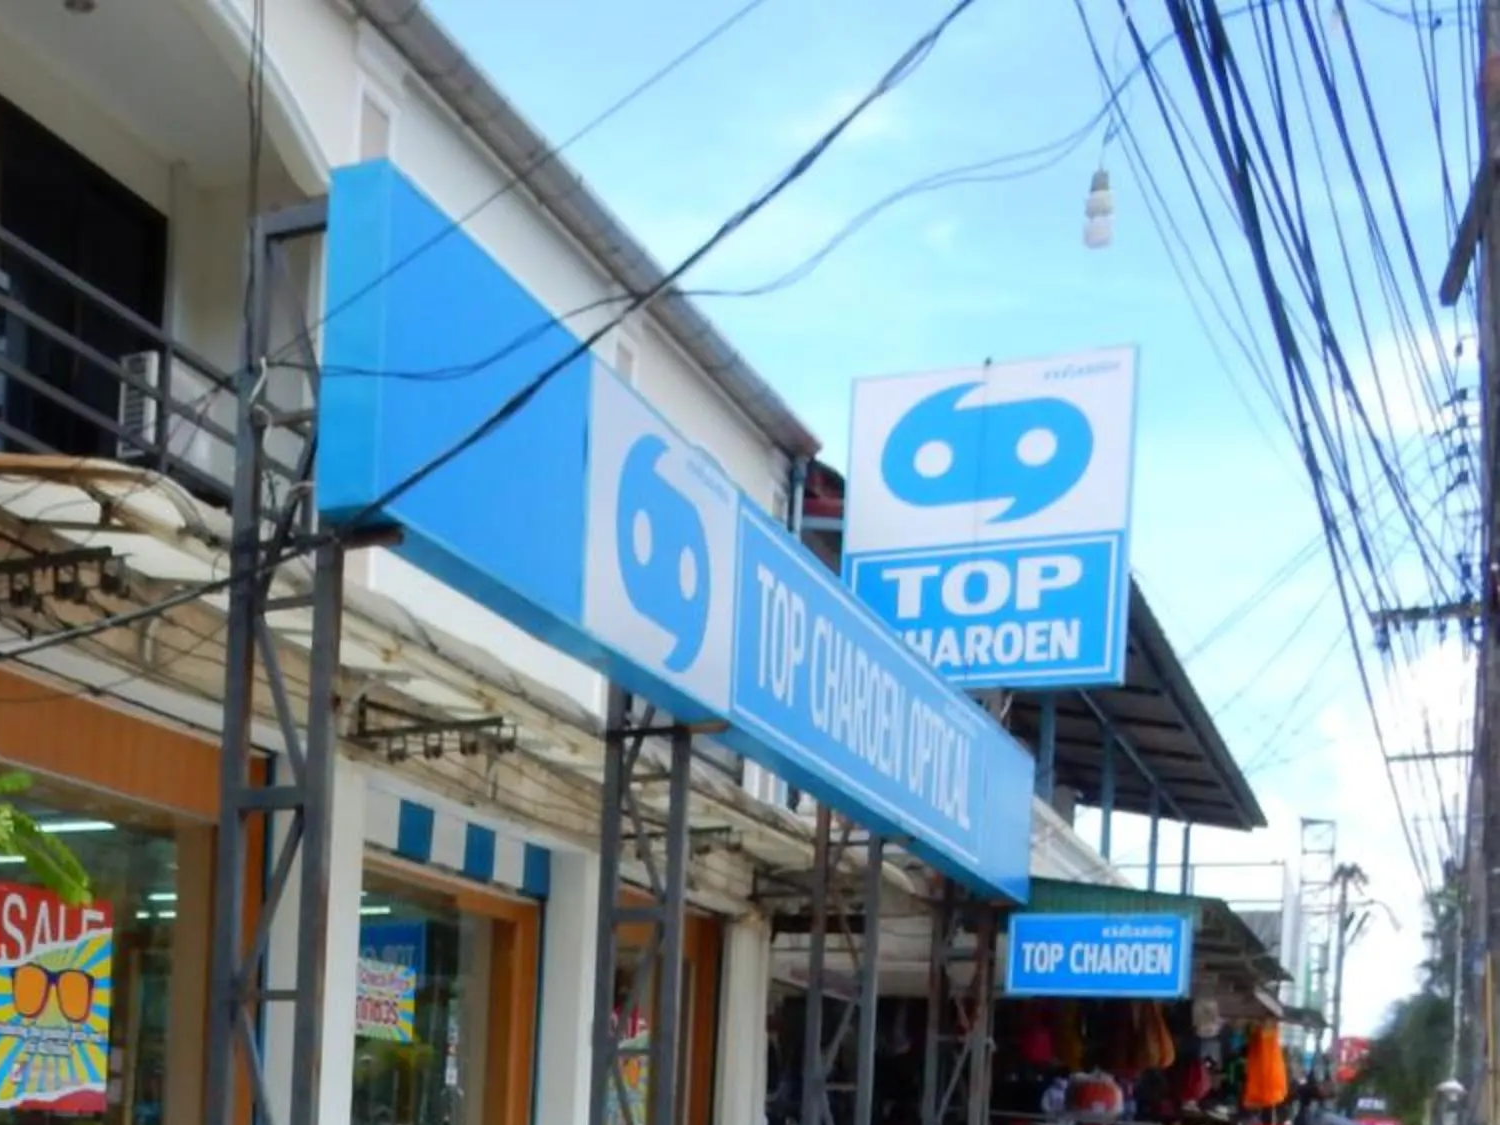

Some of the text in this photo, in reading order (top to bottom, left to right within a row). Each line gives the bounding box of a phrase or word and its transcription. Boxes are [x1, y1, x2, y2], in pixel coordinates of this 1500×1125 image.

[881, 554, 1084, 619] TOP
[899, 618, 1081, 668] HAROEN
[757, 562, 971, 832] TOP CHAROEN OPTICAL
[1021, 941, 1174, 975] TOP CHAROEN
